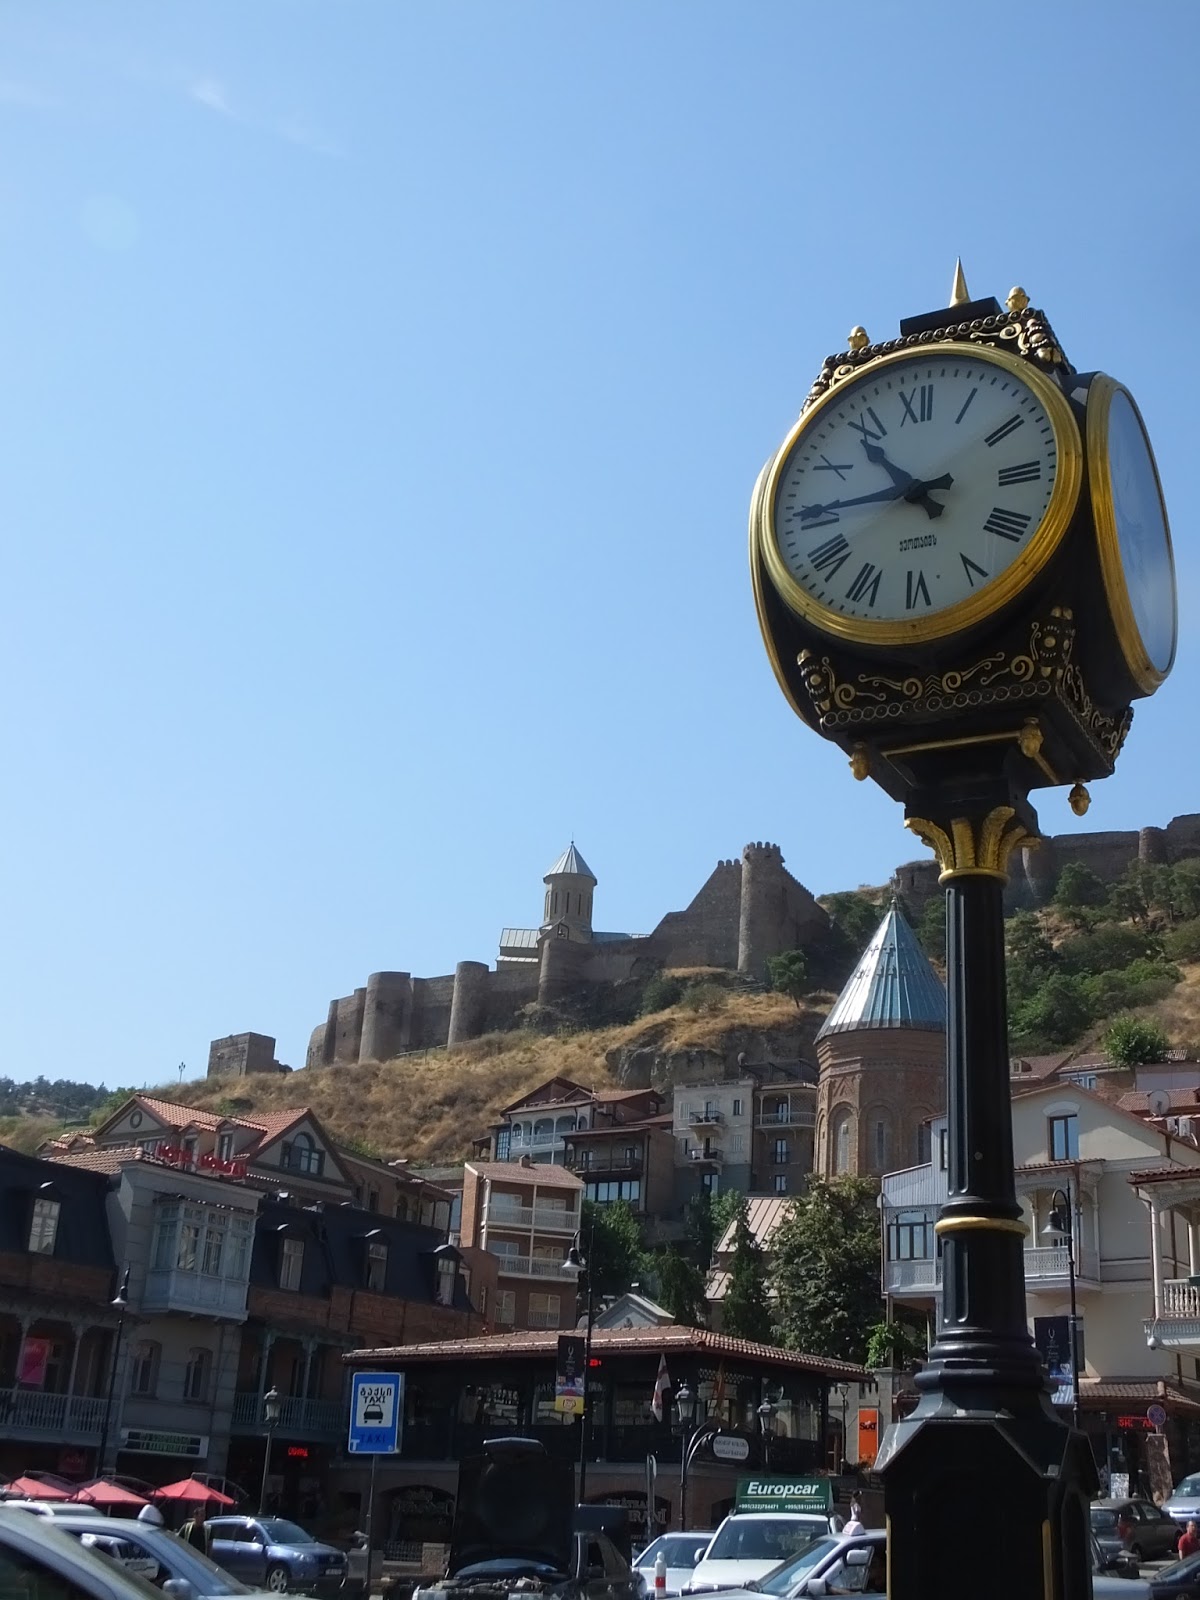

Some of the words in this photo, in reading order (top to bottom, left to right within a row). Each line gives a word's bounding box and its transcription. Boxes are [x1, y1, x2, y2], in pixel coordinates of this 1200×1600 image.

[898, 384, 934, 427] XII
[847, 407, 888, 442] XI
[984, 414, 1025, 447] II
[813, 454, 854, 480] X
[998, 460, 1041, 487] III
[807, 533, 852, 583] VIII
[959, 552, 989, 587] V
[845, 562, 883, 607] VII
[905, 569, 932, 609] VI
[360, 1387, 392, 1396] ტაქსი
[363, 1396, 386, 1404] TAXI
[747, 1481, 820, 1499] Europcar
